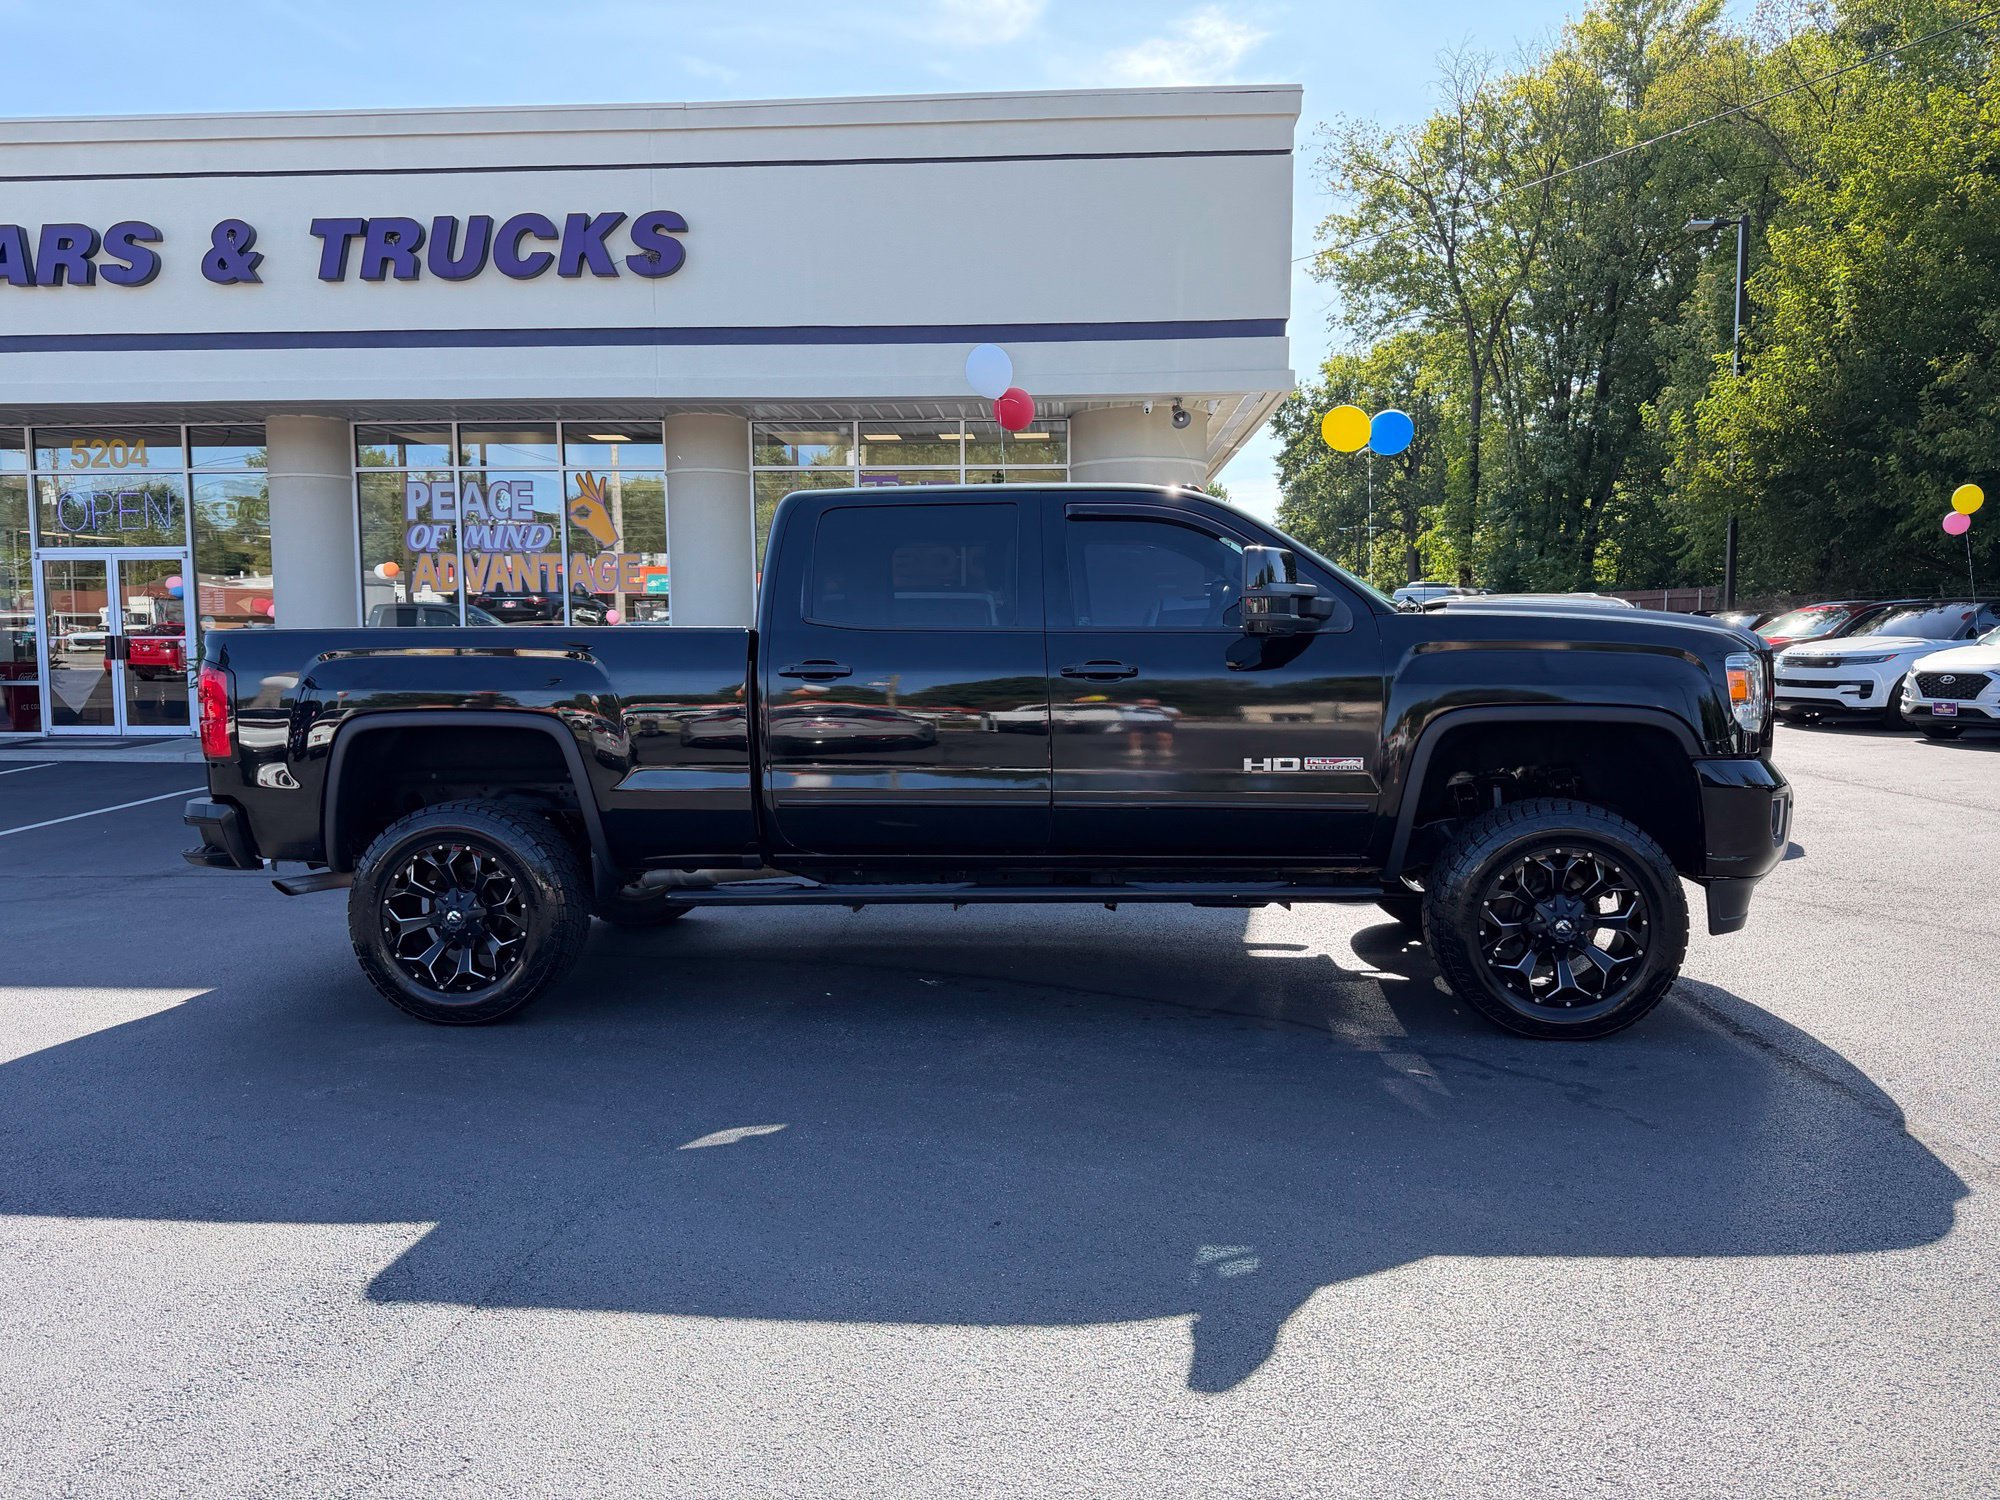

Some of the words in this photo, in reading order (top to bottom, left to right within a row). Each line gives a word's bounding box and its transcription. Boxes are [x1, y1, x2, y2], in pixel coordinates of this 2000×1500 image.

[201, 219, 263, 284] &
[311, 210, 688, 282] TRUCKS
[70, 438, 148, 468] 5204
[57, 492, 171, 532] OPEN
[405, 480, 534, 521] PEACE
[406, 523, 450, 552] OF
[462, 523, 553, 552] MIND
[410, 551, 645, 593] ADVANTAGE
[1243, 757, 1300, 772] HD
